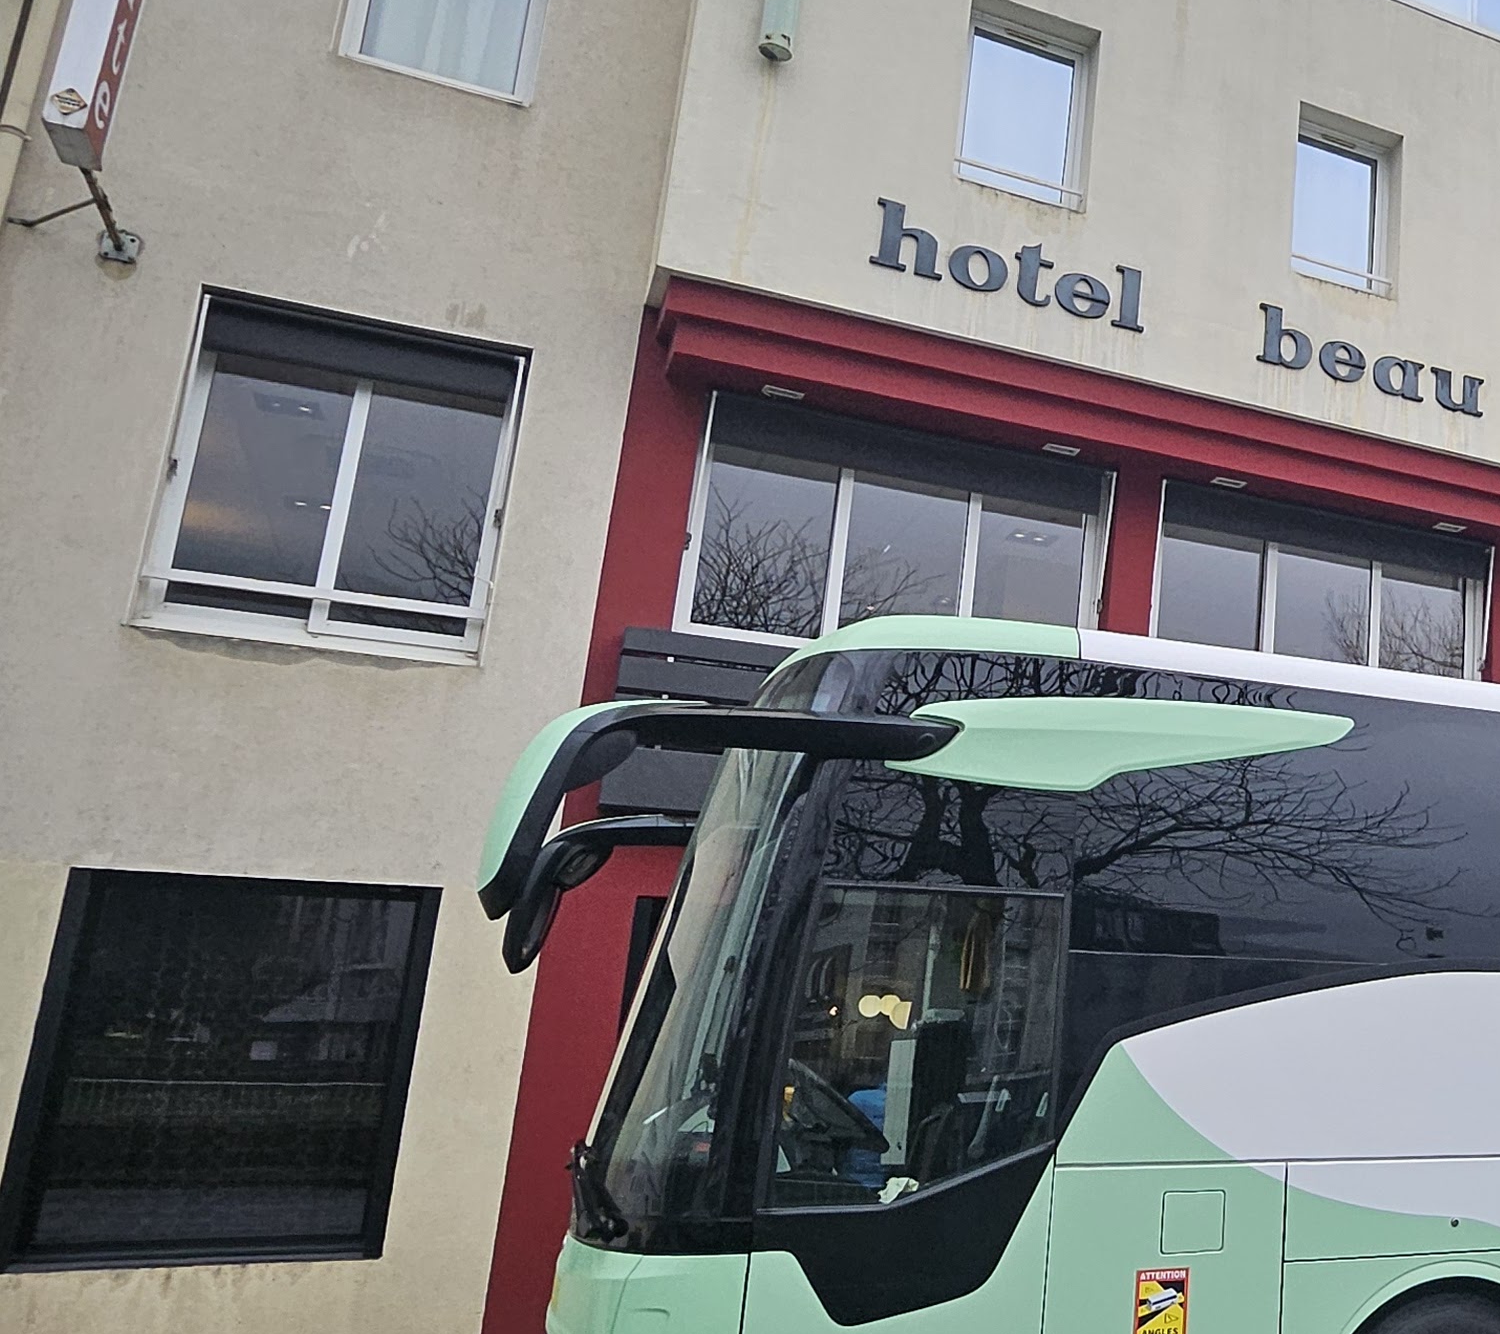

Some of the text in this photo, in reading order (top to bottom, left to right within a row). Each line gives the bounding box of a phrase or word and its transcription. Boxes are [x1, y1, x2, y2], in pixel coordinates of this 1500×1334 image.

[869, 197, 1145, 334] hotel
[1256, 302, 1485, 418] beau
[1139, 1269, 1187, 1281] ATTENTION
